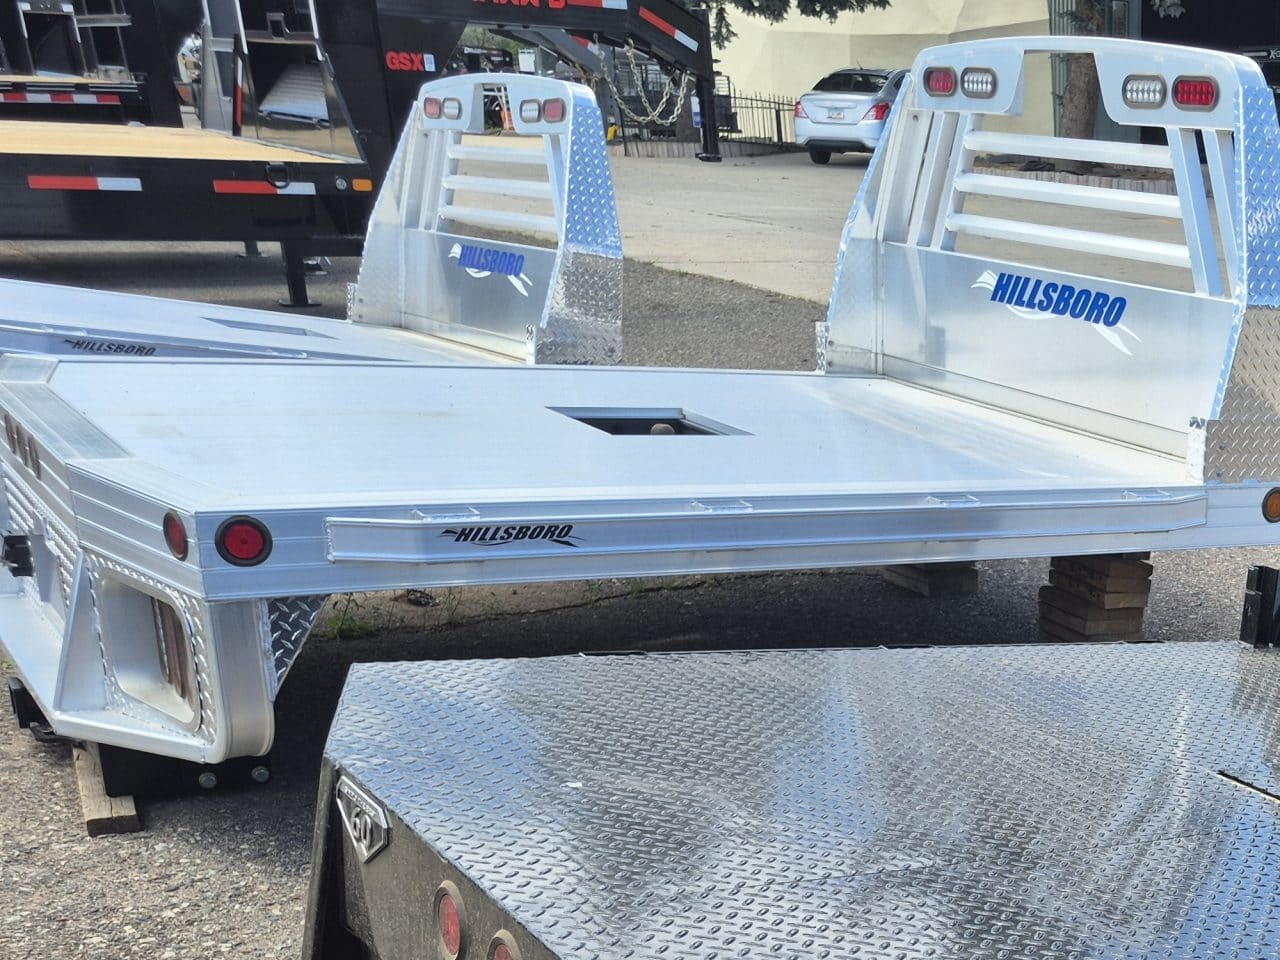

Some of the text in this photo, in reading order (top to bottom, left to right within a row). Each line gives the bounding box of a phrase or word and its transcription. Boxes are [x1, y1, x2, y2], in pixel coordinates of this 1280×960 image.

[385, 51, 424, 71] GSX
[458, 244, 525, 277] HILLSBORO
[990, 272, 1127, 327] HILLSBORO
[72, 339, 157, 356] HILLSBORO
[455, 525, 574, 542] HILLSBORO
